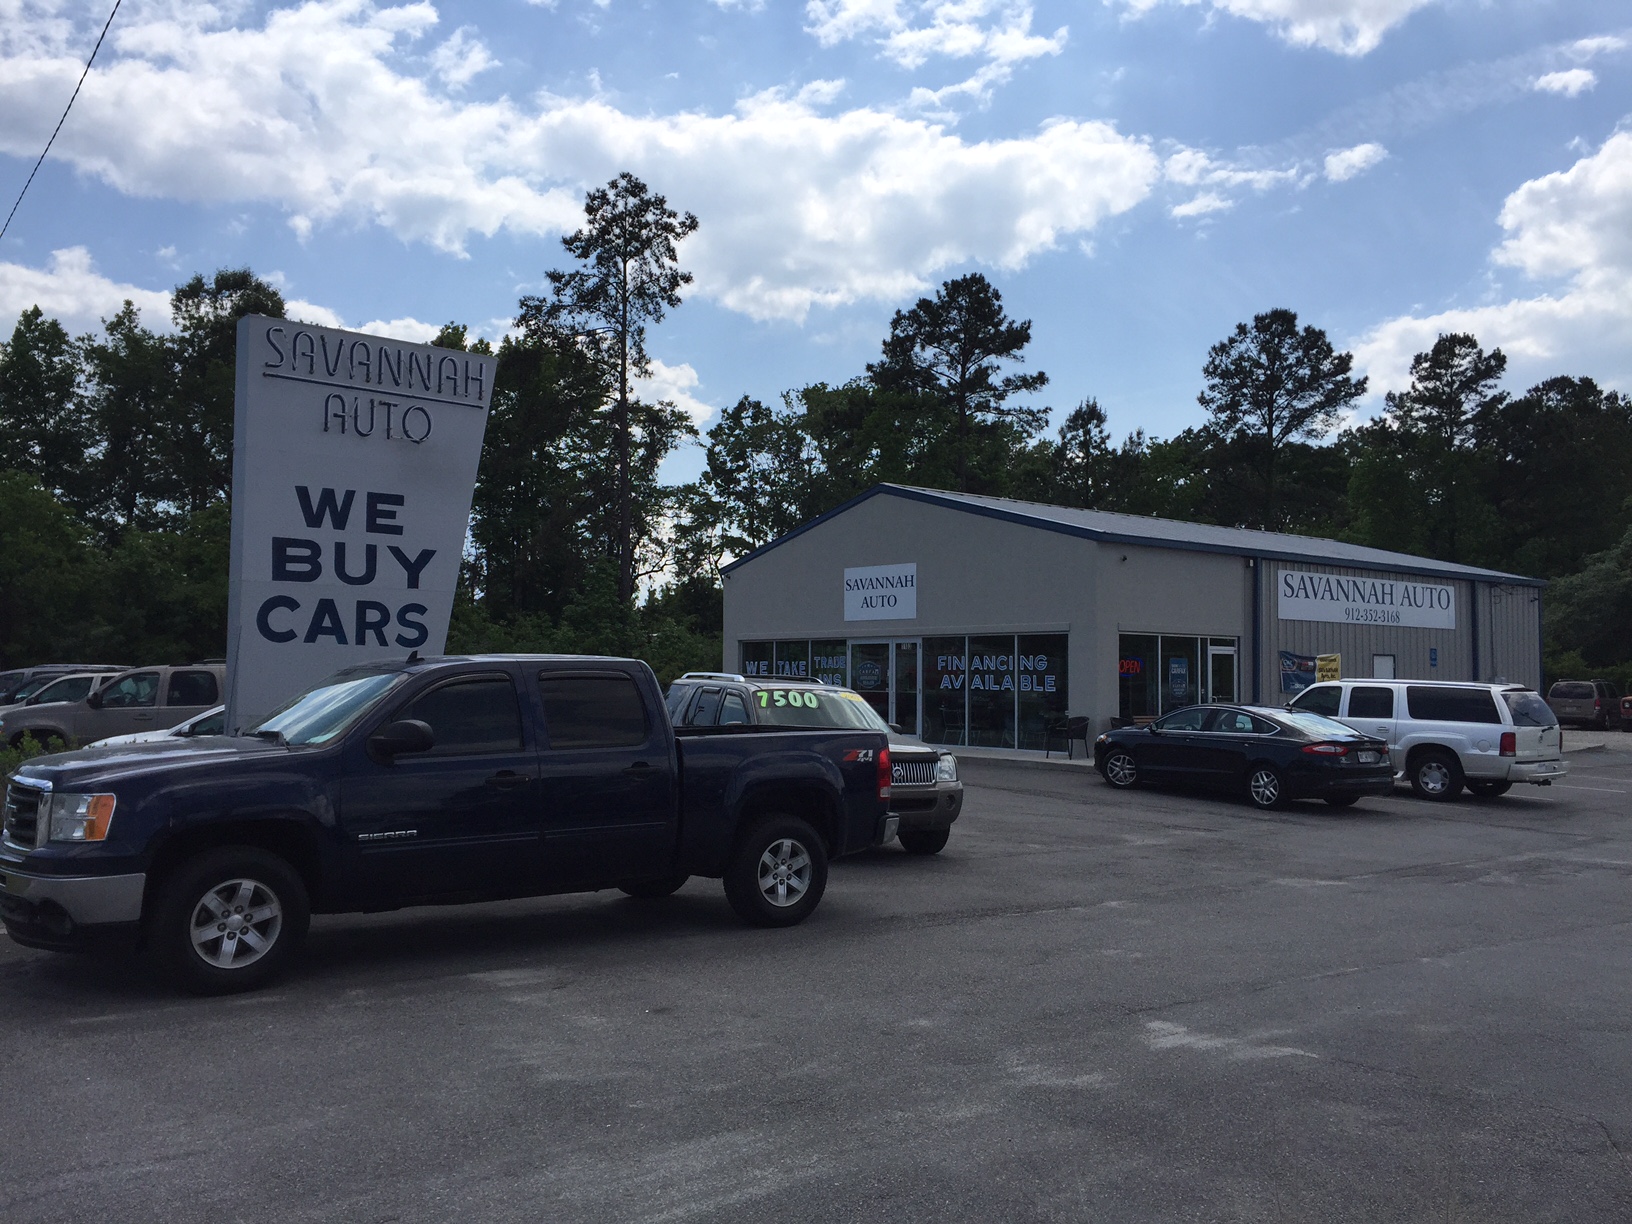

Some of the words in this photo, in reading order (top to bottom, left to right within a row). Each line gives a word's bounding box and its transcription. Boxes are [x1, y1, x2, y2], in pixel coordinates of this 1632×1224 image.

[264, 326, 486, 400] SAVANNAH
[323, 392, 433, 444] AUTO
[295, 485, 405, 535] WE
[272, 536, 437, 589] BUY
[845, 574, 915, 591] SAVANNAH
[1283, 573, 1395, 606] SAVANNAH
[1399, 584, 1451, 610] AUTO
[860, 594, 898, 608] AUTO
[256, 595, 429, 648] CARS
[1344, 607, 1401, 624] 912-352-3168
[745, 661, 769, 675] WE
[777, 661, 807, 676] TAKE
[813, 656, 847, 669] TRADE
[937, 654, 1048, 671] FINANCING
[1119, 660, 1141, 673] OPEN
[940, 674, 1056, 692] AVAILABLE
[757, 690, 819, 709] 7500
